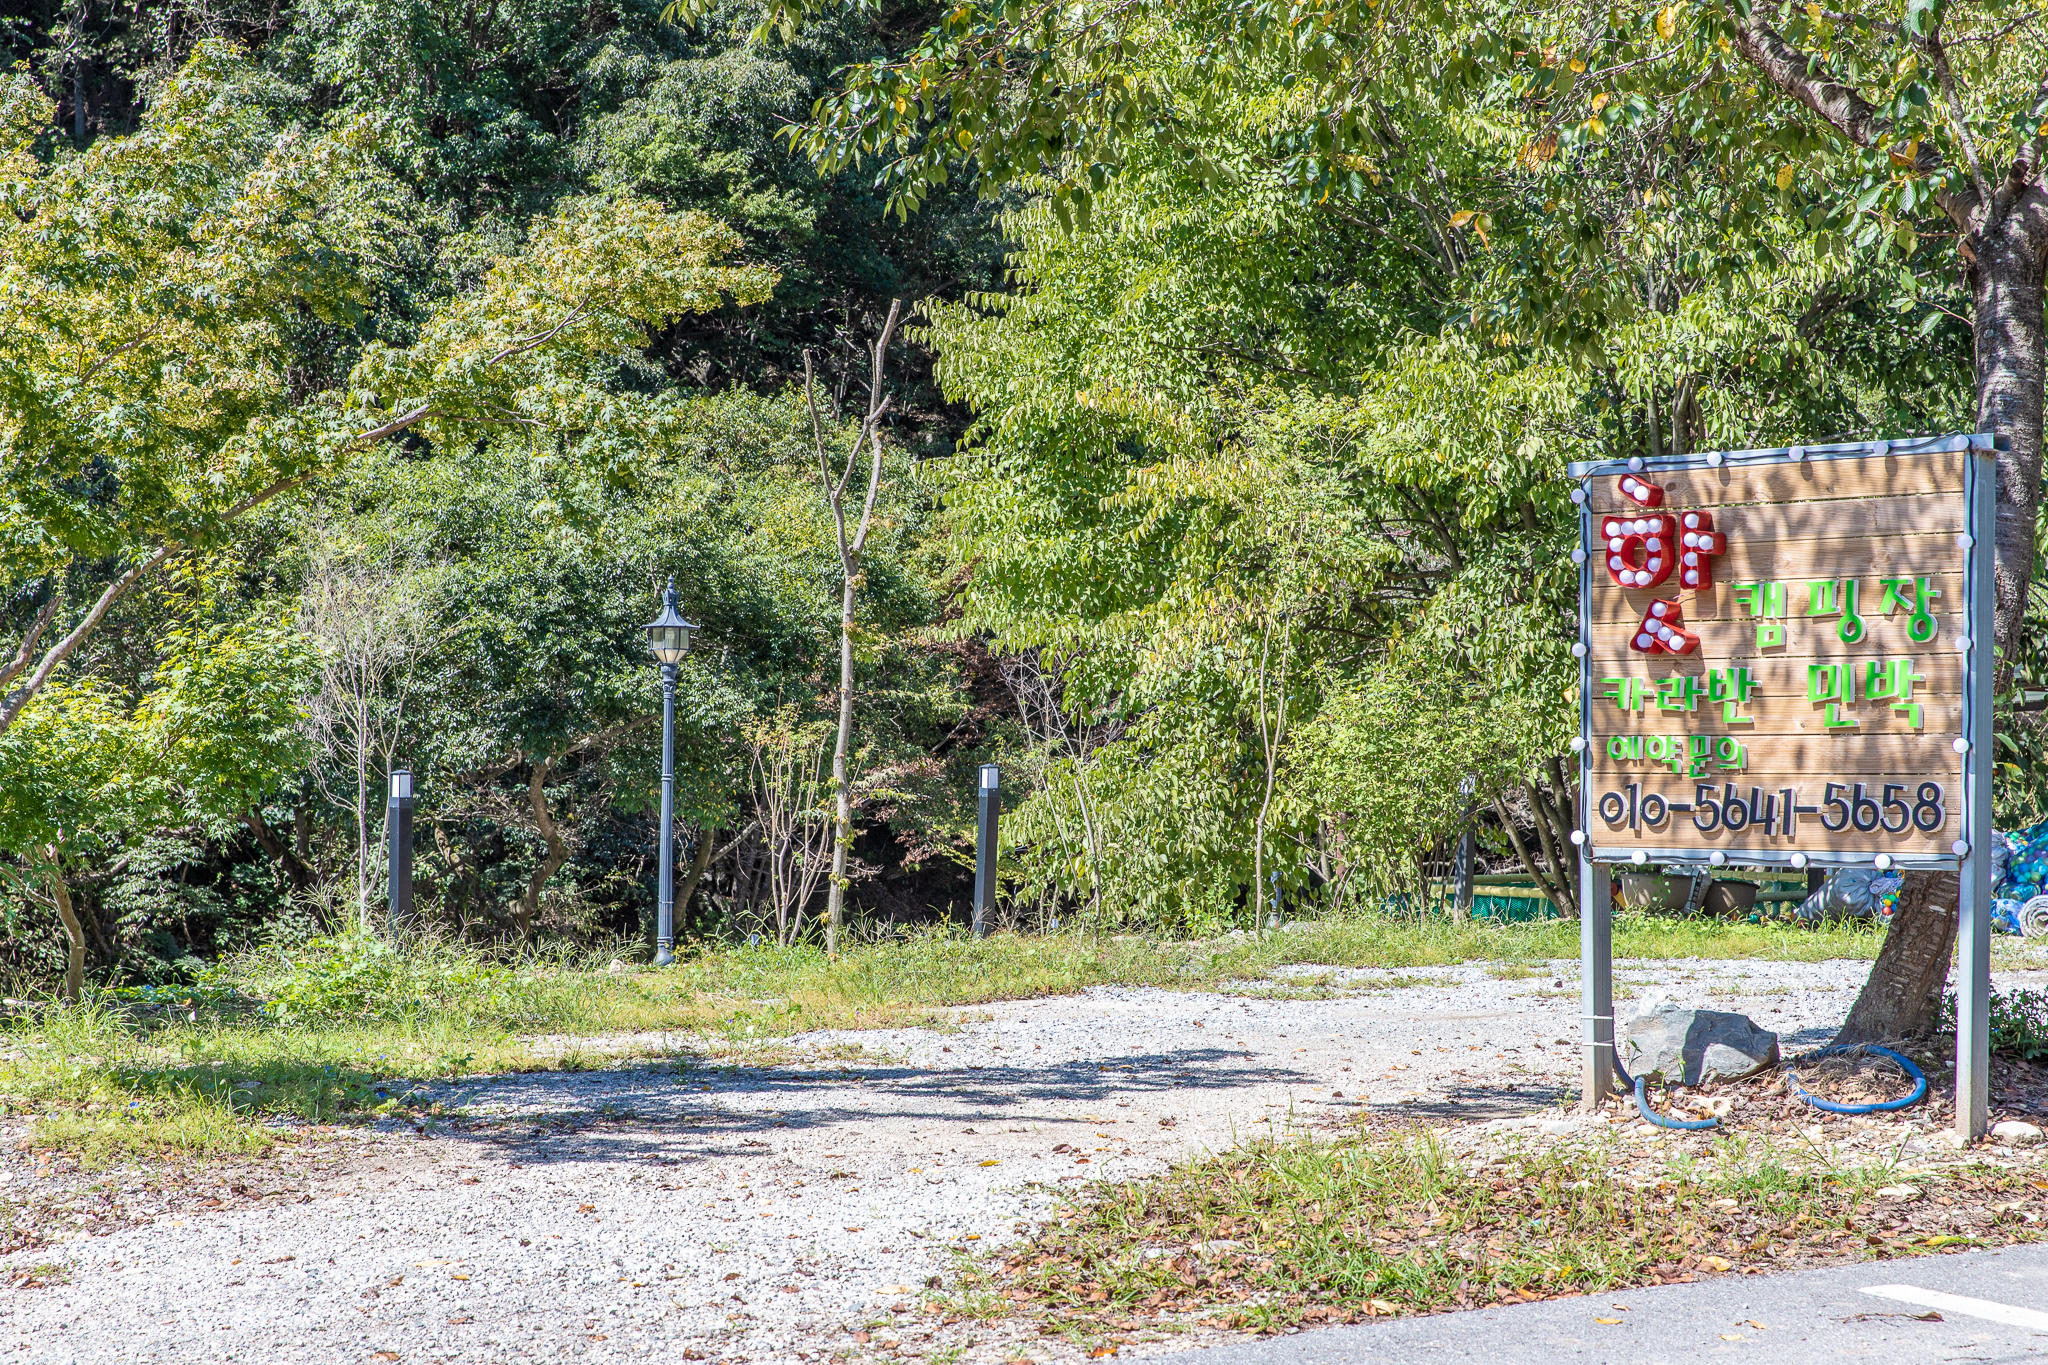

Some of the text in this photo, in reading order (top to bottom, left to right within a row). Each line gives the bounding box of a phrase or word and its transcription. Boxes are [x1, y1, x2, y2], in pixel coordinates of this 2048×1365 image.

[1732, 577, 1942, 648] 캠핑장
[1600, 659, 1926, 729] 카라반 민박
[1599, 781, 1946, 837] 010-5641-5658
